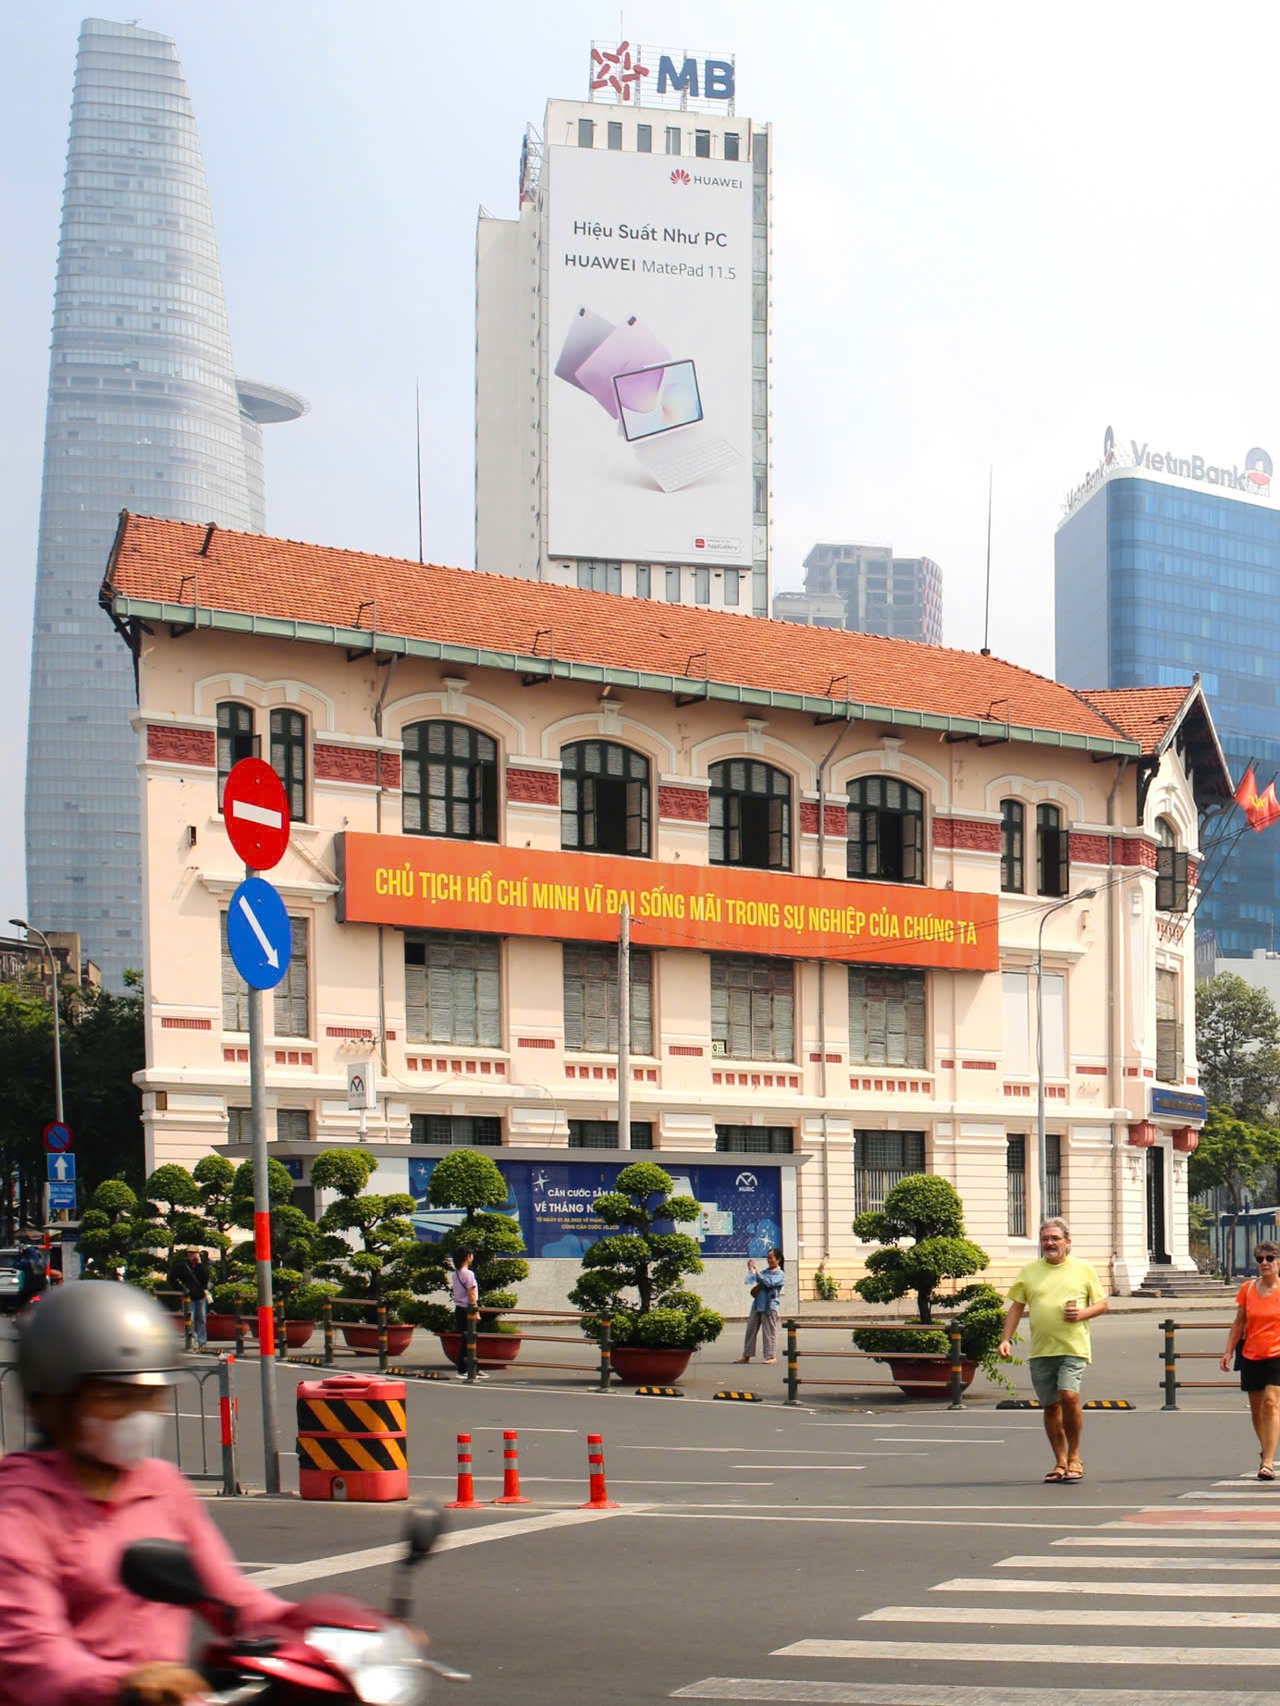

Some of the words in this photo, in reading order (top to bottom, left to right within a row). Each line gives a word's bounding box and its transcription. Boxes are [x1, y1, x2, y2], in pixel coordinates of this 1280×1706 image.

[657, 55, 735, 99] MB
[694, 175, 743, 189] HUAWEI
[573, 221, 613, 241] Hiệu
[618, 223, 657, 242] Suất
[663, 228, 699, 245] Như
[705, 232, 727, 248] PC
[565, 254, 637, 272] HUAWEI
[642, 260, 704, 278] MatePad
[708, 265, 736, 280] 11.5
[1130, 440, 1246, 491] VietinBank
[375, 862, 414, 897] CHỦ
[419, 871, 461, 904] TỊCH
[467, 870, 494, 904] HỒ
[497, 877, 529, 907] CHÍ
[533, 883, 579, 912] MINH
[584, 883, 604, 914] VĨ
[640, 885, 685, 919] SỐNG
[690, 886, 722, 923] MÃI
[726, 899, 780, 928] TRONG
[783, 904, 805, 935] SỰ
[808, 906, 866, 939] NGHIỆP
[869, 906, 900, 938] CỦA
[904, 913, 955, 943] CHÚNG
[958, 920, 977, 945] TA
[548, 1188, 565, 1197] CĂN
[567, 1188, 591, 1197] CƯỚC
[534, 1201, 547, 1213] VÉ
[549, 1201, 584, 1213] THÁNG
